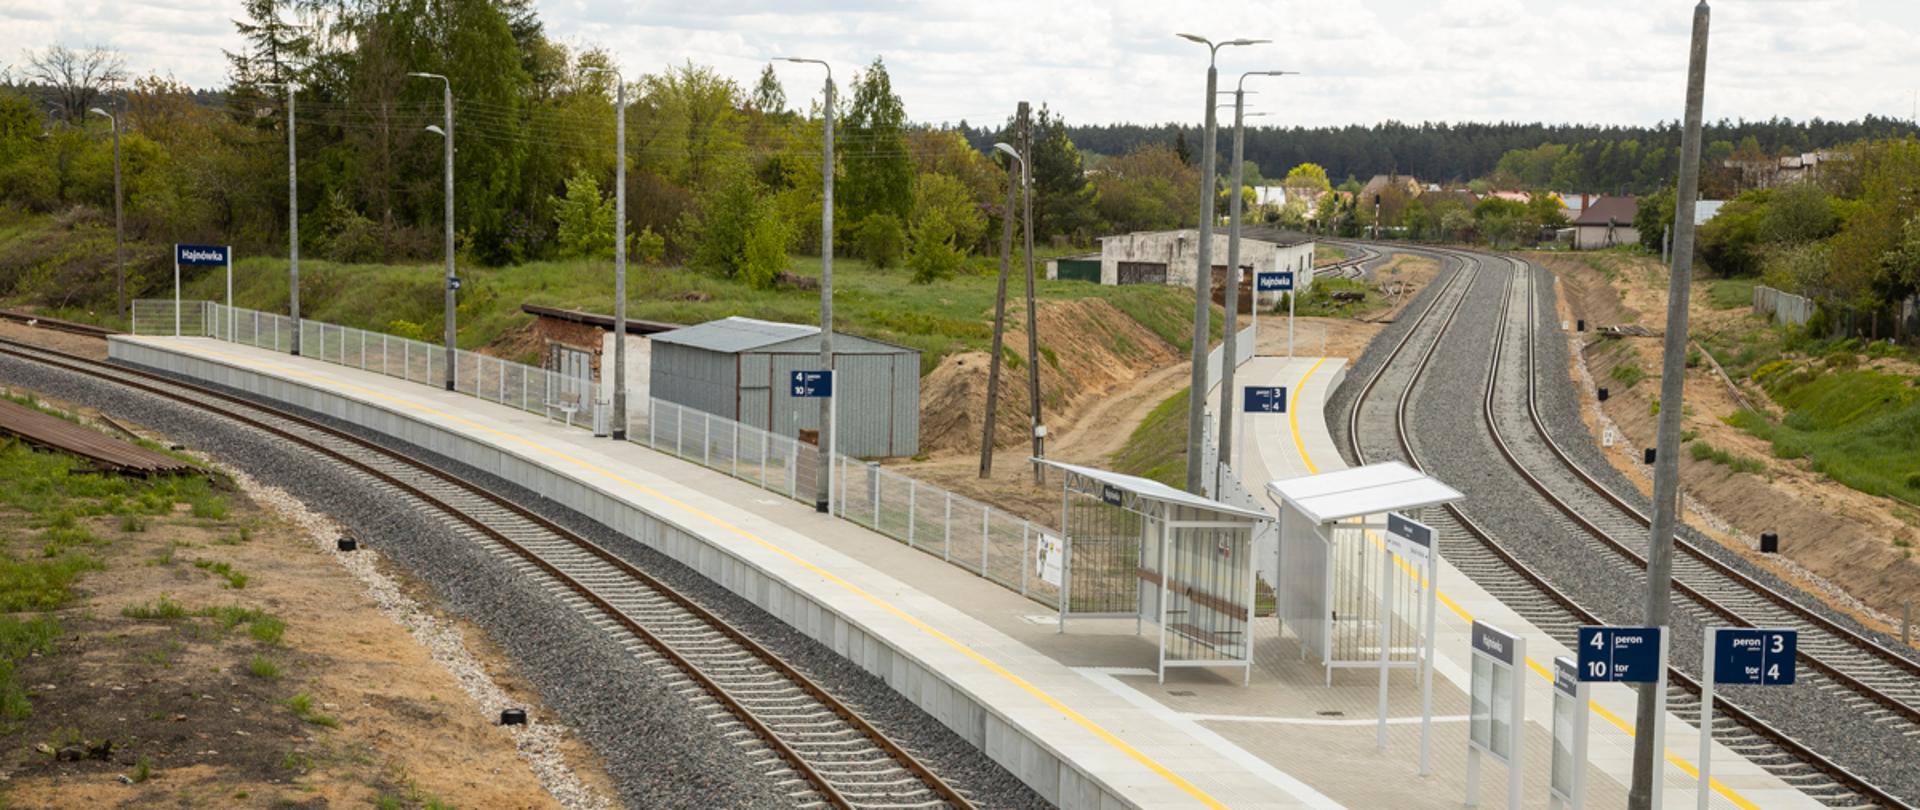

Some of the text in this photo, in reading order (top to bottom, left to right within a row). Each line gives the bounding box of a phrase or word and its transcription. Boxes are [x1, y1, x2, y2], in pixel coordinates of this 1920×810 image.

[182, 249, 223, 263] Hajnówka
[1260, 274, 1291, 289] Hajnówka
[796, 371, 803, 382] 4
[795, 386, 804, 395] 10
[1273, 388, 1281, 398] 3
[1273, 402, 1279, 411] 4
[1590, 632, 1643, 650] 4 peron
[1733, 634, 1784, 653] peron 3
[1588, 661, 1607, 677] 10
[1614, 663, 1629, 672] tor
[1745, 663, 1780, 680] tor 4
